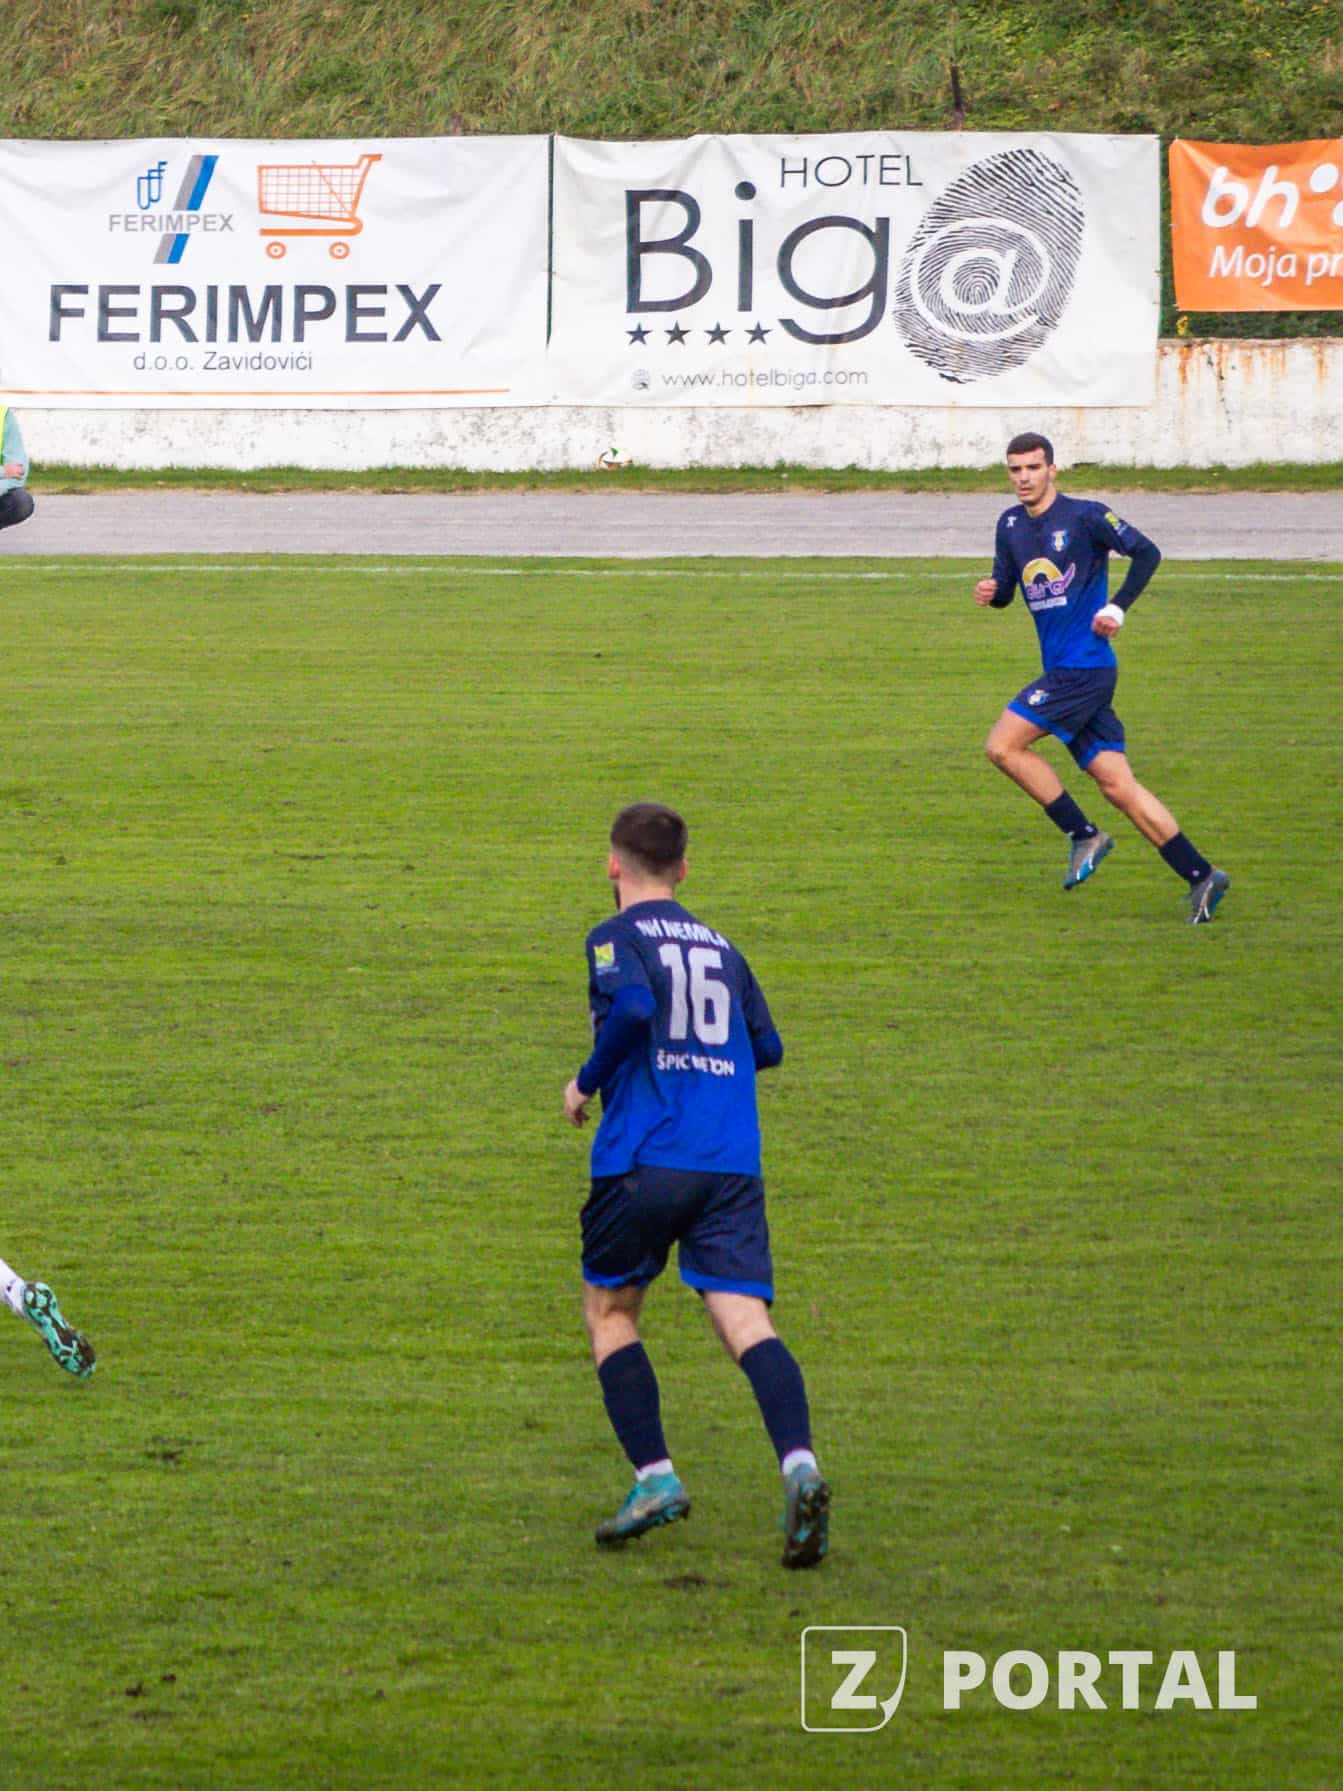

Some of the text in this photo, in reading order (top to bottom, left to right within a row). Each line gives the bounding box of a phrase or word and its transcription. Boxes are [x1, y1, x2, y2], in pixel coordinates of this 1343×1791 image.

[779, 154, 923, 188] HOTEL
[109, 213, 234, 232] FERIMPEX
[1208, 245, 1297, 287] Moja
[48, 283, 443, 343] FERIMPEX
[133, 350, 313, 371] d.o.o. Zavidovići
[662, 368, 869, 391] www.hotelbiga.com
[658, 942, 731, 1046] 16
